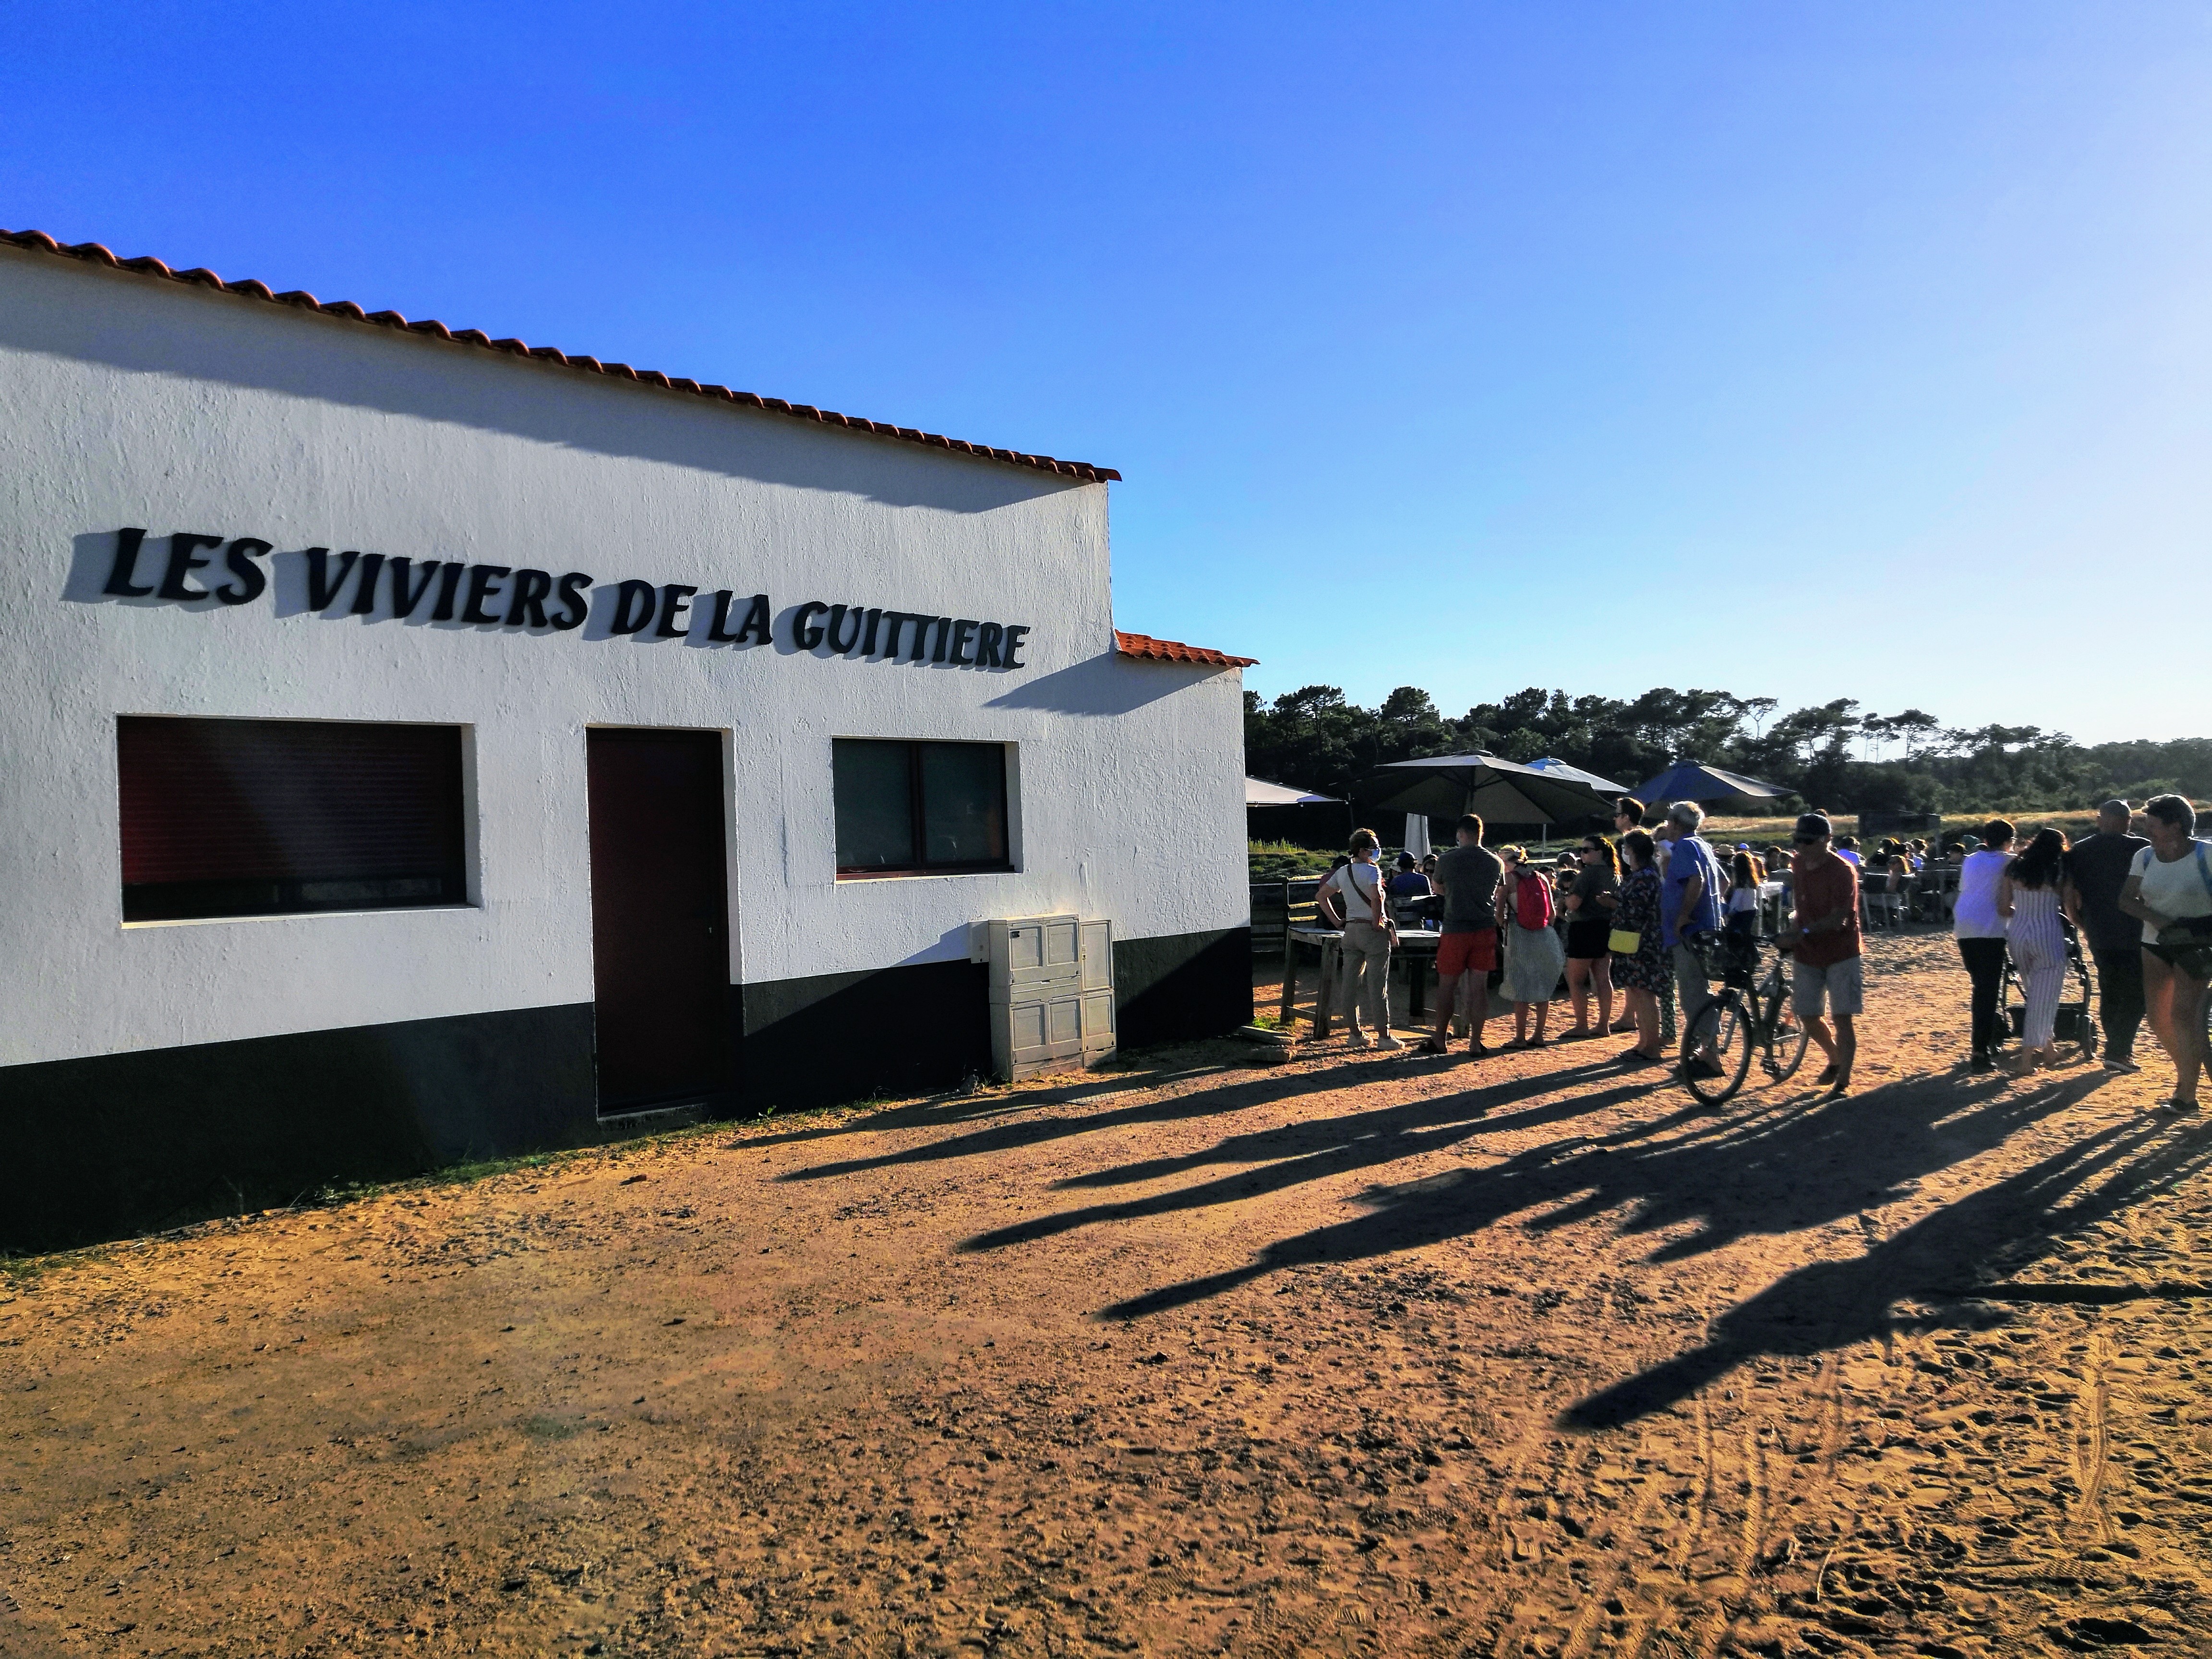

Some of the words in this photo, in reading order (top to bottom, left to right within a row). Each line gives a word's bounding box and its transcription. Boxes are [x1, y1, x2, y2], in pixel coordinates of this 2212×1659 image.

[103, 527, 274, 605] LES
[307, 547, 594, 630] VIVIERS
[610, 579, 698, 638] DE
[708, 589, 773, 645] LA
[793, 601, 1031, 670] GUITTIERE
